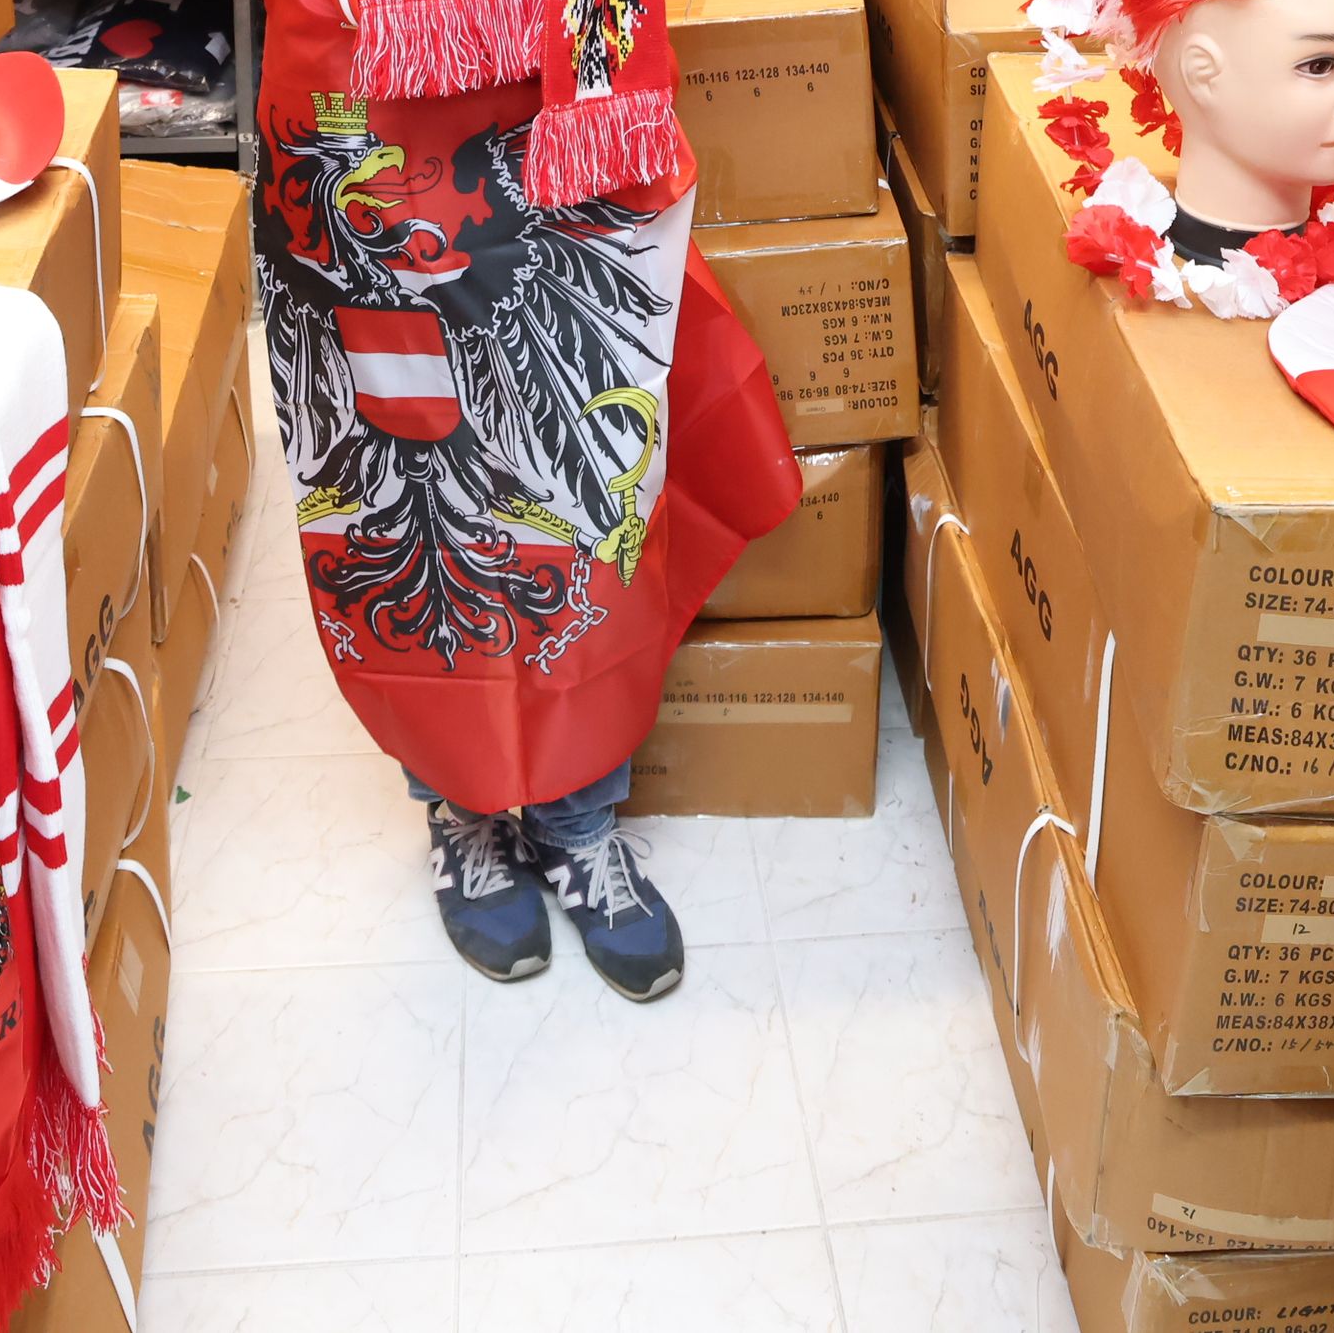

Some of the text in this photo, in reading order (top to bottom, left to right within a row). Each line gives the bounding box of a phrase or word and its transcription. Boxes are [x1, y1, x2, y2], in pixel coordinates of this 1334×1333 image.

[686, 63, 829, 85] 110-116 122-128 134-140
[1024, 299, 1058, 401] AGG
[1011, 529, 1052, 641] AGG
[1235, 671, 1284, 690] G.W.:
[1295, 676, 1305, 691] 7
[1238, 645, 1283, 663] QTY:
[1293, 650, 1316, 666] 36
[960, 674, 993, 786] AGG
